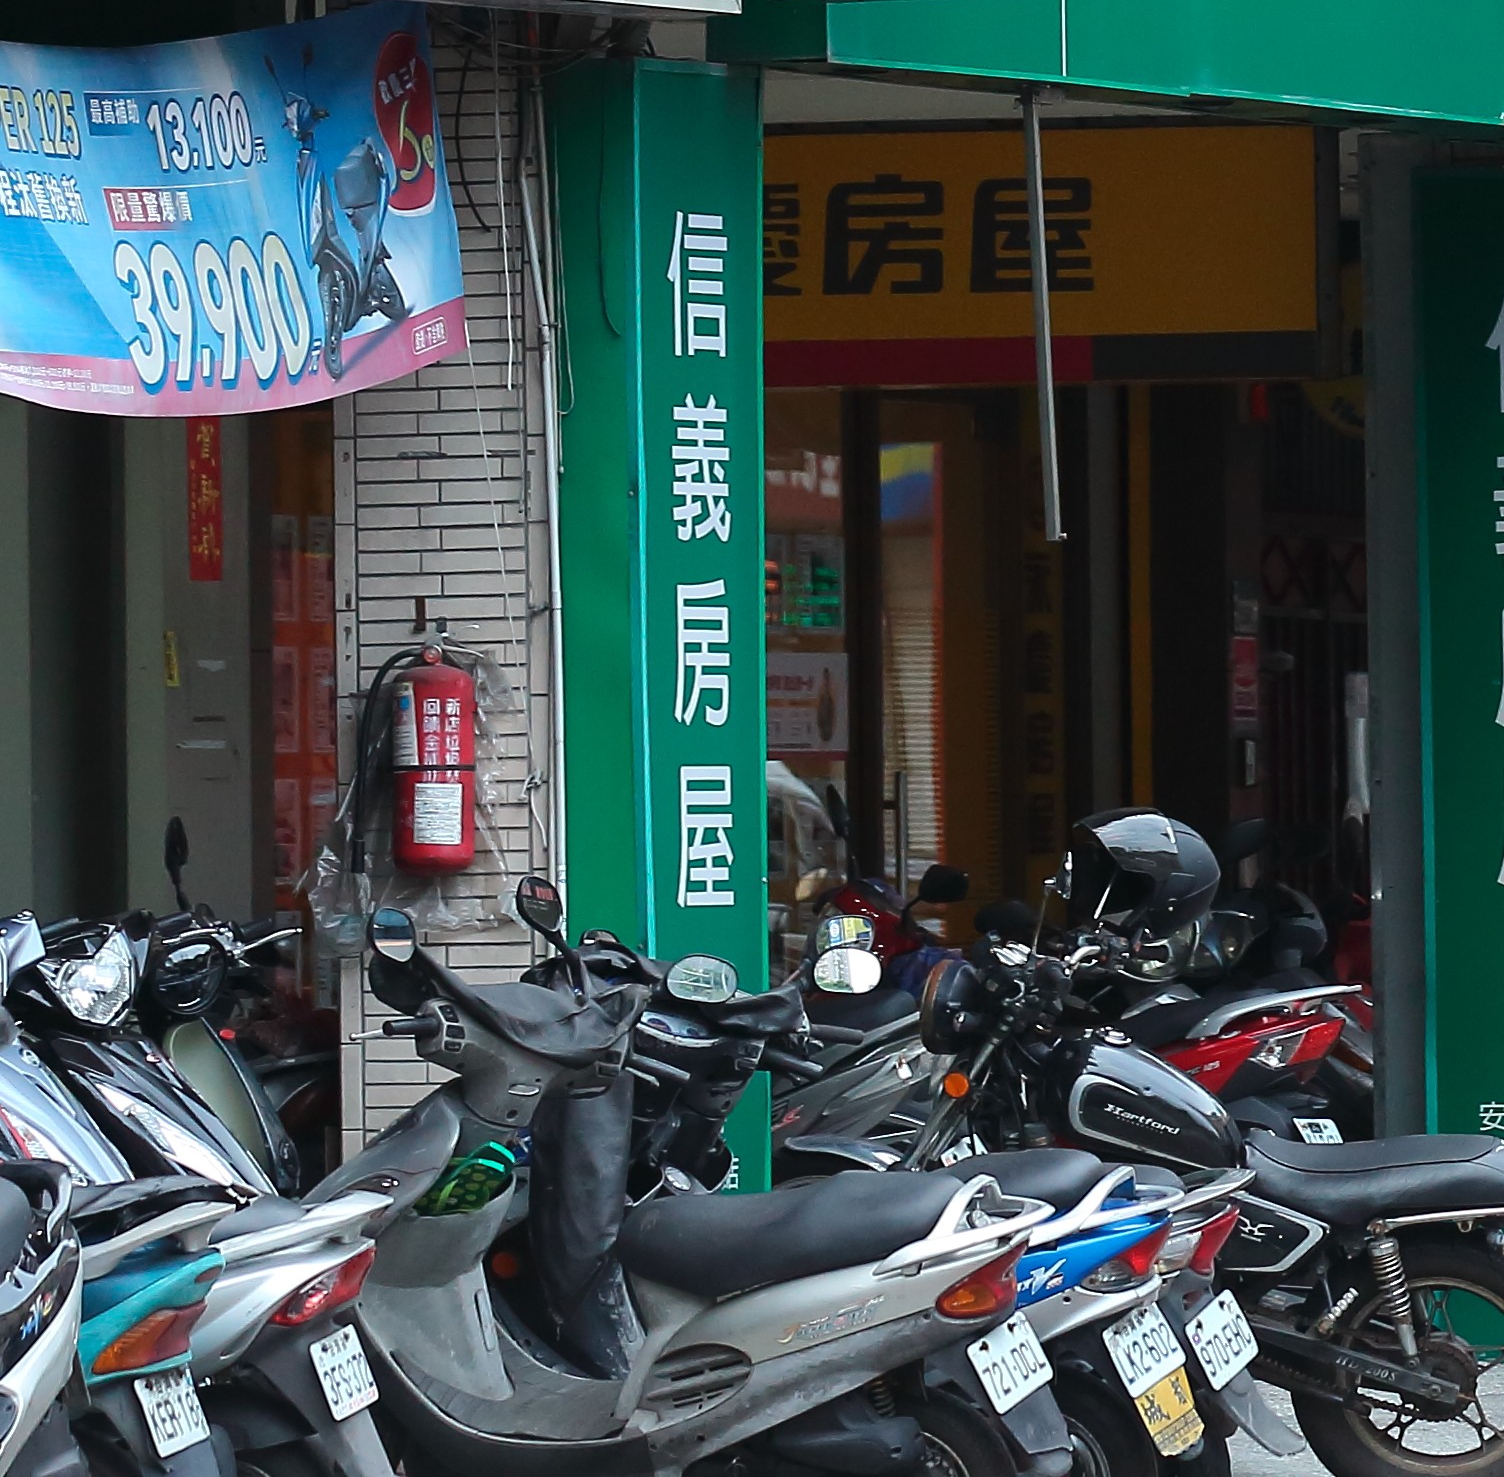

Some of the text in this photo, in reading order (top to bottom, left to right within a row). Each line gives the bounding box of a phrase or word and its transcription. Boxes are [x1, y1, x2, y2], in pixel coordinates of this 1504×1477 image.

[33, 89, 81, 160] 125
[90, 98, 140, 125] 最高補助
[666, 211, 735, 908] 信義房屋
[1104, 1103, 1181, 1135] Hartford
[982, 1342, 1047, 1400] 721-DCL
[1116, 1324, 1179, 1385] LK2-602
[1199, 1314, 1253, 1378] 970-EHC
